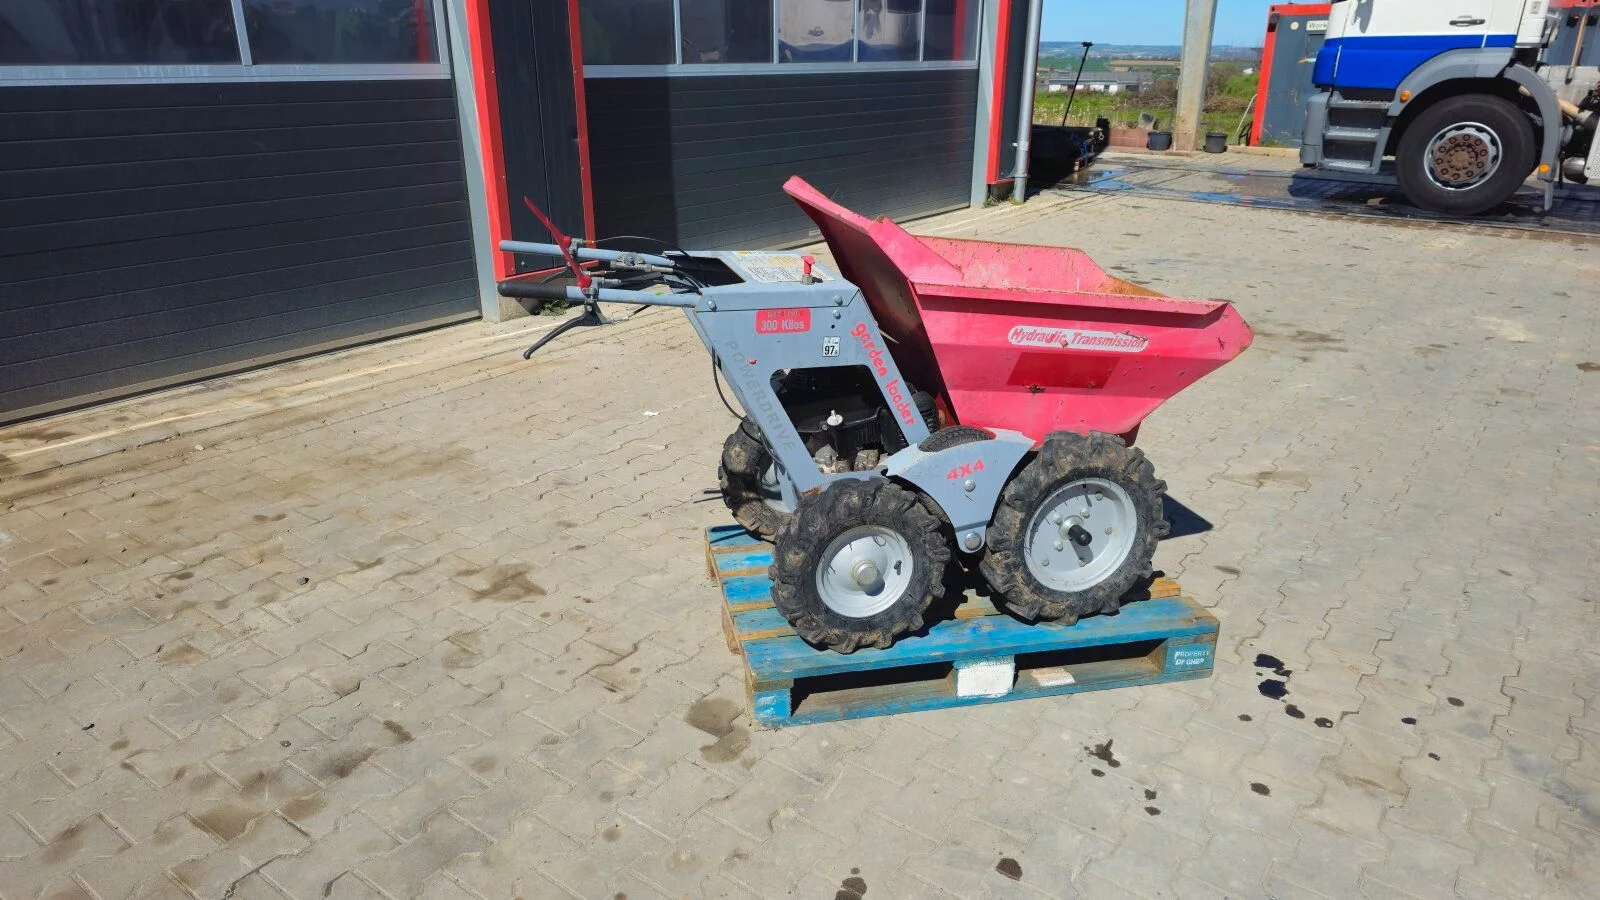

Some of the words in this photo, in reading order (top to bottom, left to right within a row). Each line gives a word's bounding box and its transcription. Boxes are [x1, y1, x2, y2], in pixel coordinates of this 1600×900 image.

[761, 320, 778, 331] 300
[781, 319, 805, 330] Kilos
[1010, 327, 1068, 345] Hydraulic
[1071, 332, 1146, 349] Transmission
[824, 345, 835, 356] 97
[850, 323, 888, 377] garden
[885, 378, 916, 425] loader
[725, 340, 796, 452] POWERDRIVE
